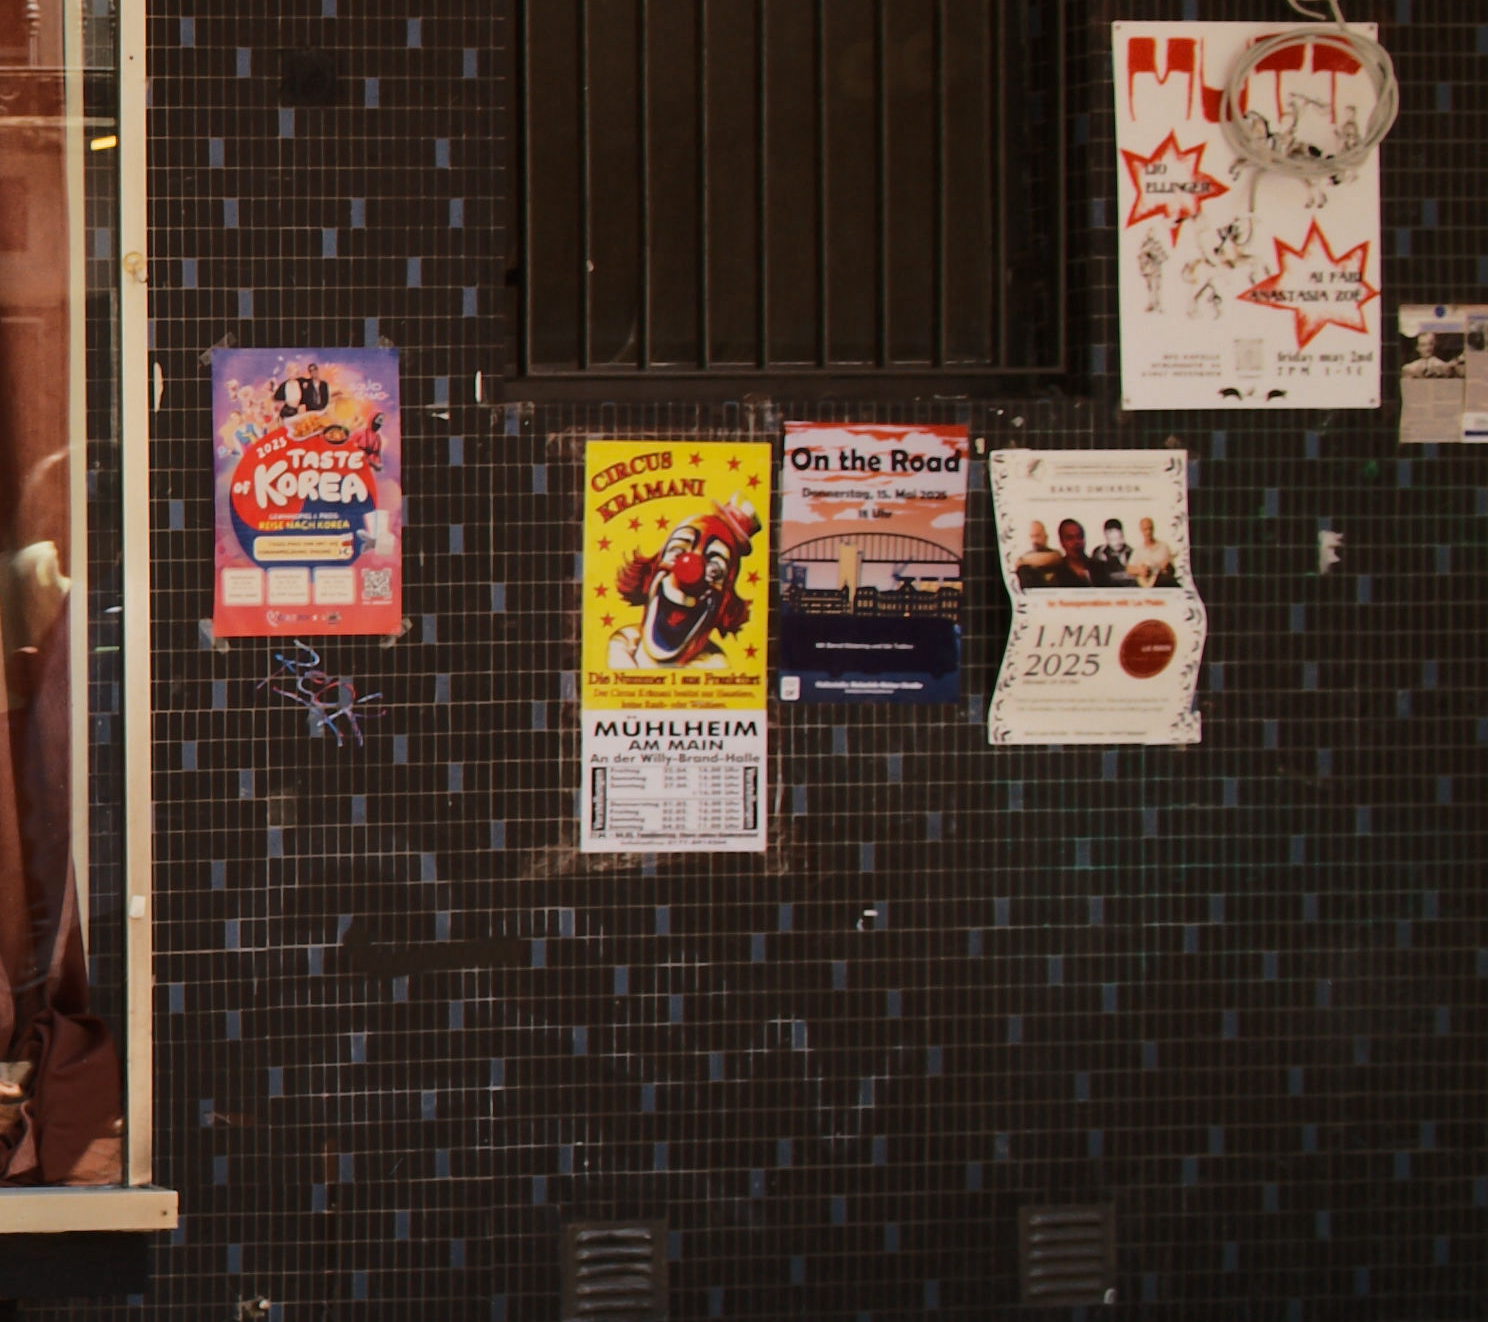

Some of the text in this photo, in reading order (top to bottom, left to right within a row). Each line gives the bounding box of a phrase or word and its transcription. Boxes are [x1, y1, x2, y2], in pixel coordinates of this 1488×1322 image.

[256, 437, 287, 459] 2025
[286, 448, 365, 470] TASTE
[791, 447, 962, 472] On the Road
[591, 451, 673, 492] CIRCUS
[254, 460, 369, 509] KOREA
[895, 489, 916, 499] Mai
[872, 509, 893, 518] Uhr
[1023, 653, 1101, 677] 2025
[588, 672, 610, 686] Die
[594, 715, 758, 737] MÜHLHEIM
[629, 740, 724, 751] AM MAIN
[590, 754, 608, 763] An
[614, 753, 635, 763] der
